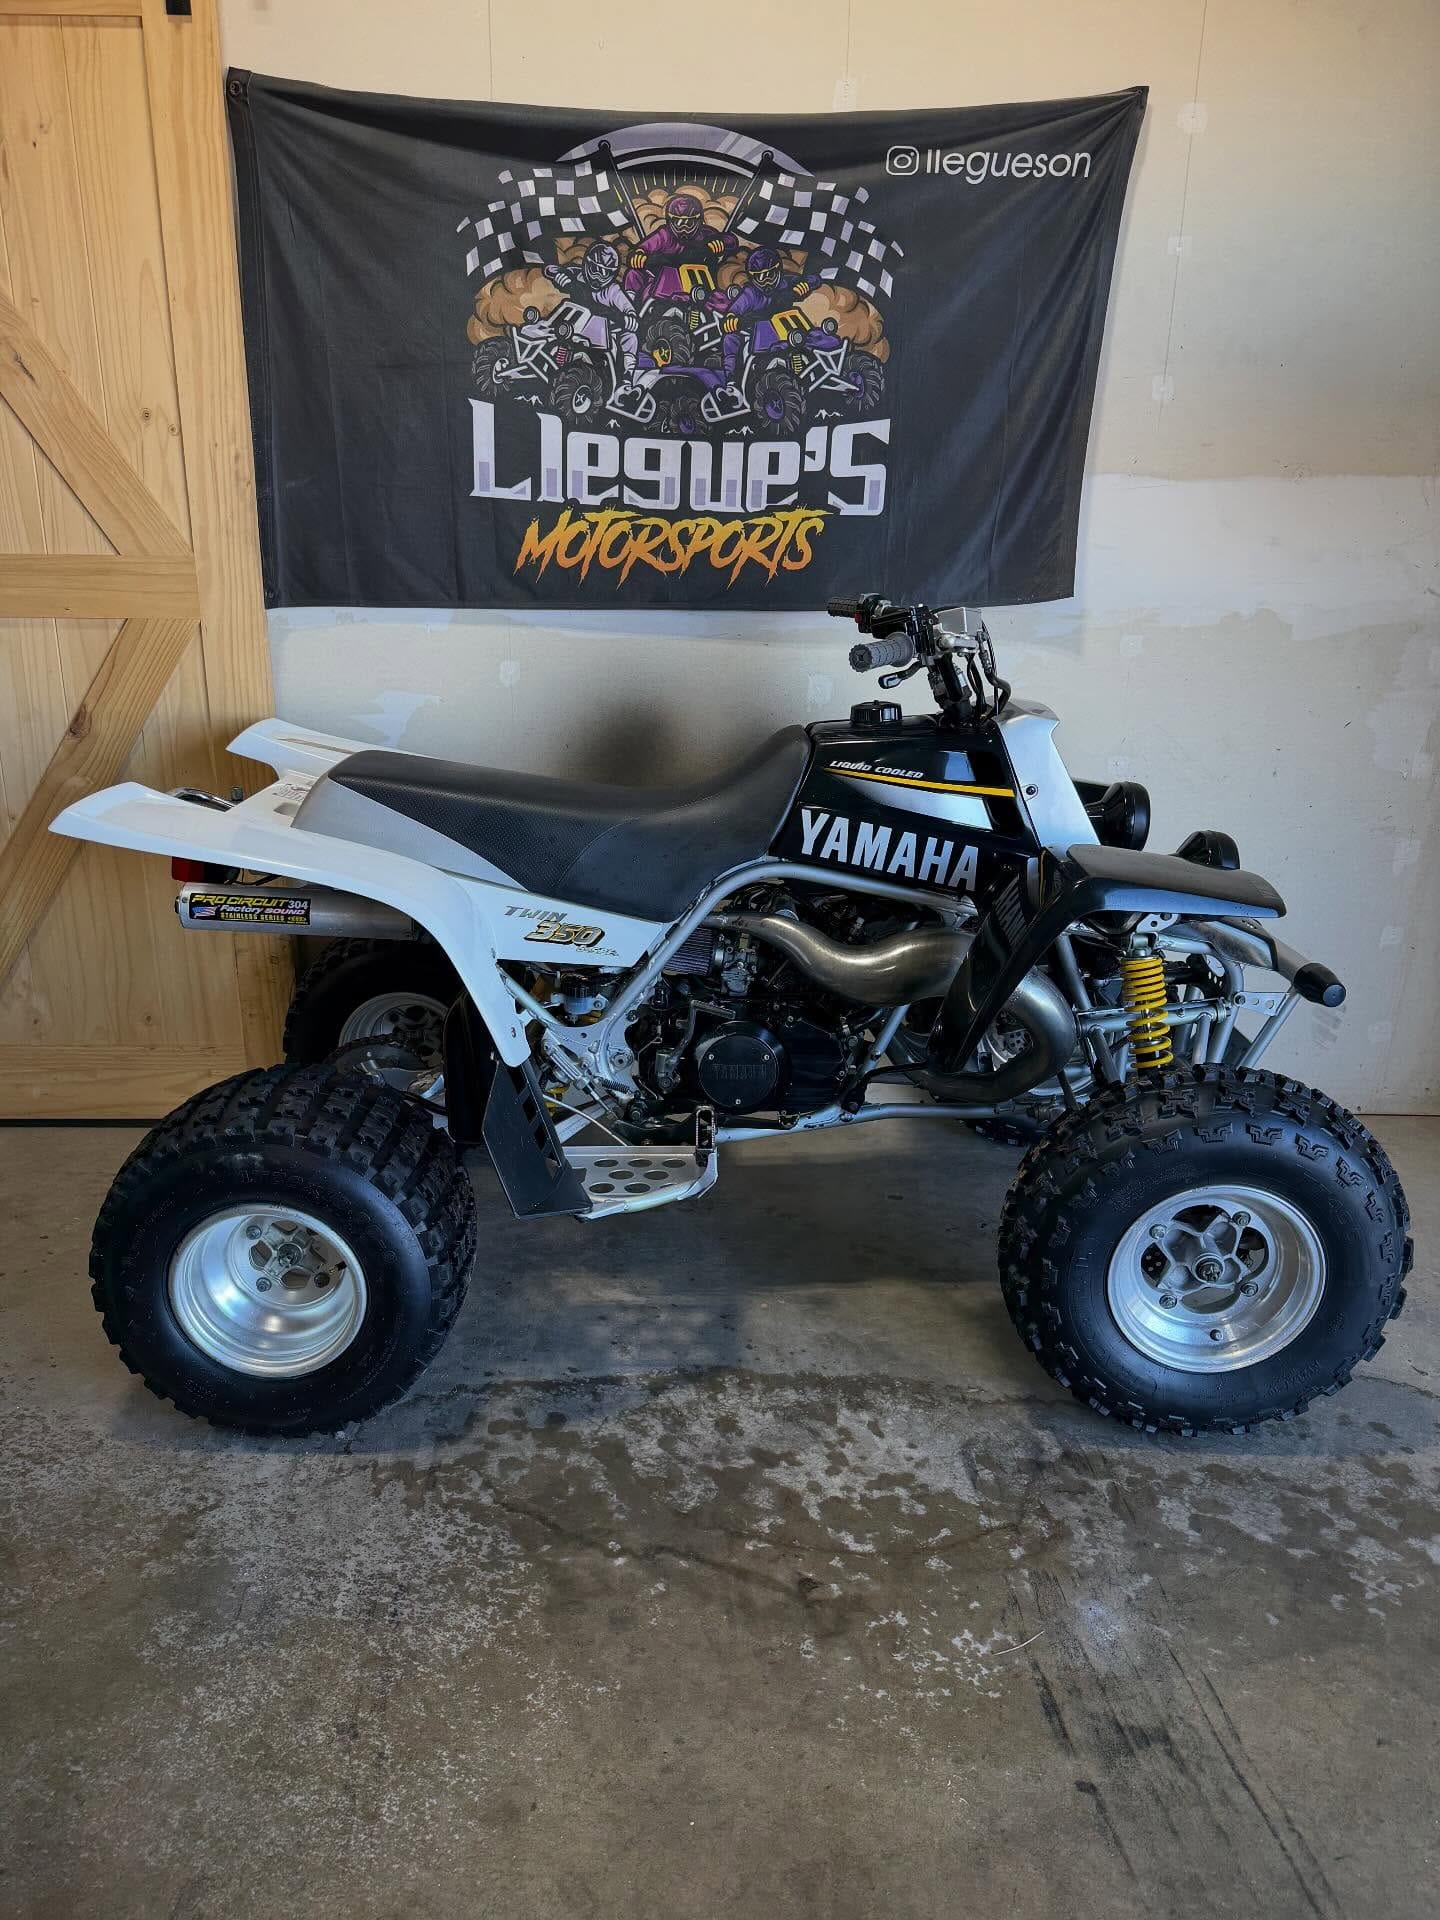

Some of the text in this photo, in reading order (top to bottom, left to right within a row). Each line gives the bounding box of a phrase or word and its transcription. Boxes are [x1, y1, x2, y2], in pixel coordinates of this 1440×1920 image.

[926, 149, 1092, 184] llegueson
[512, 505, 834, 590] MOTORSPORTS
[829, 760, 924, 779] LIQUID COOLED
[801, 808, 979, 891] YAMAHA
[191, 894, 309, 910] PRO CIRCUIT 304
[220, 904, 264, 914] Factory
[504, 906, 568, 922] TWIN
[523, 920, 605, 948] 350
